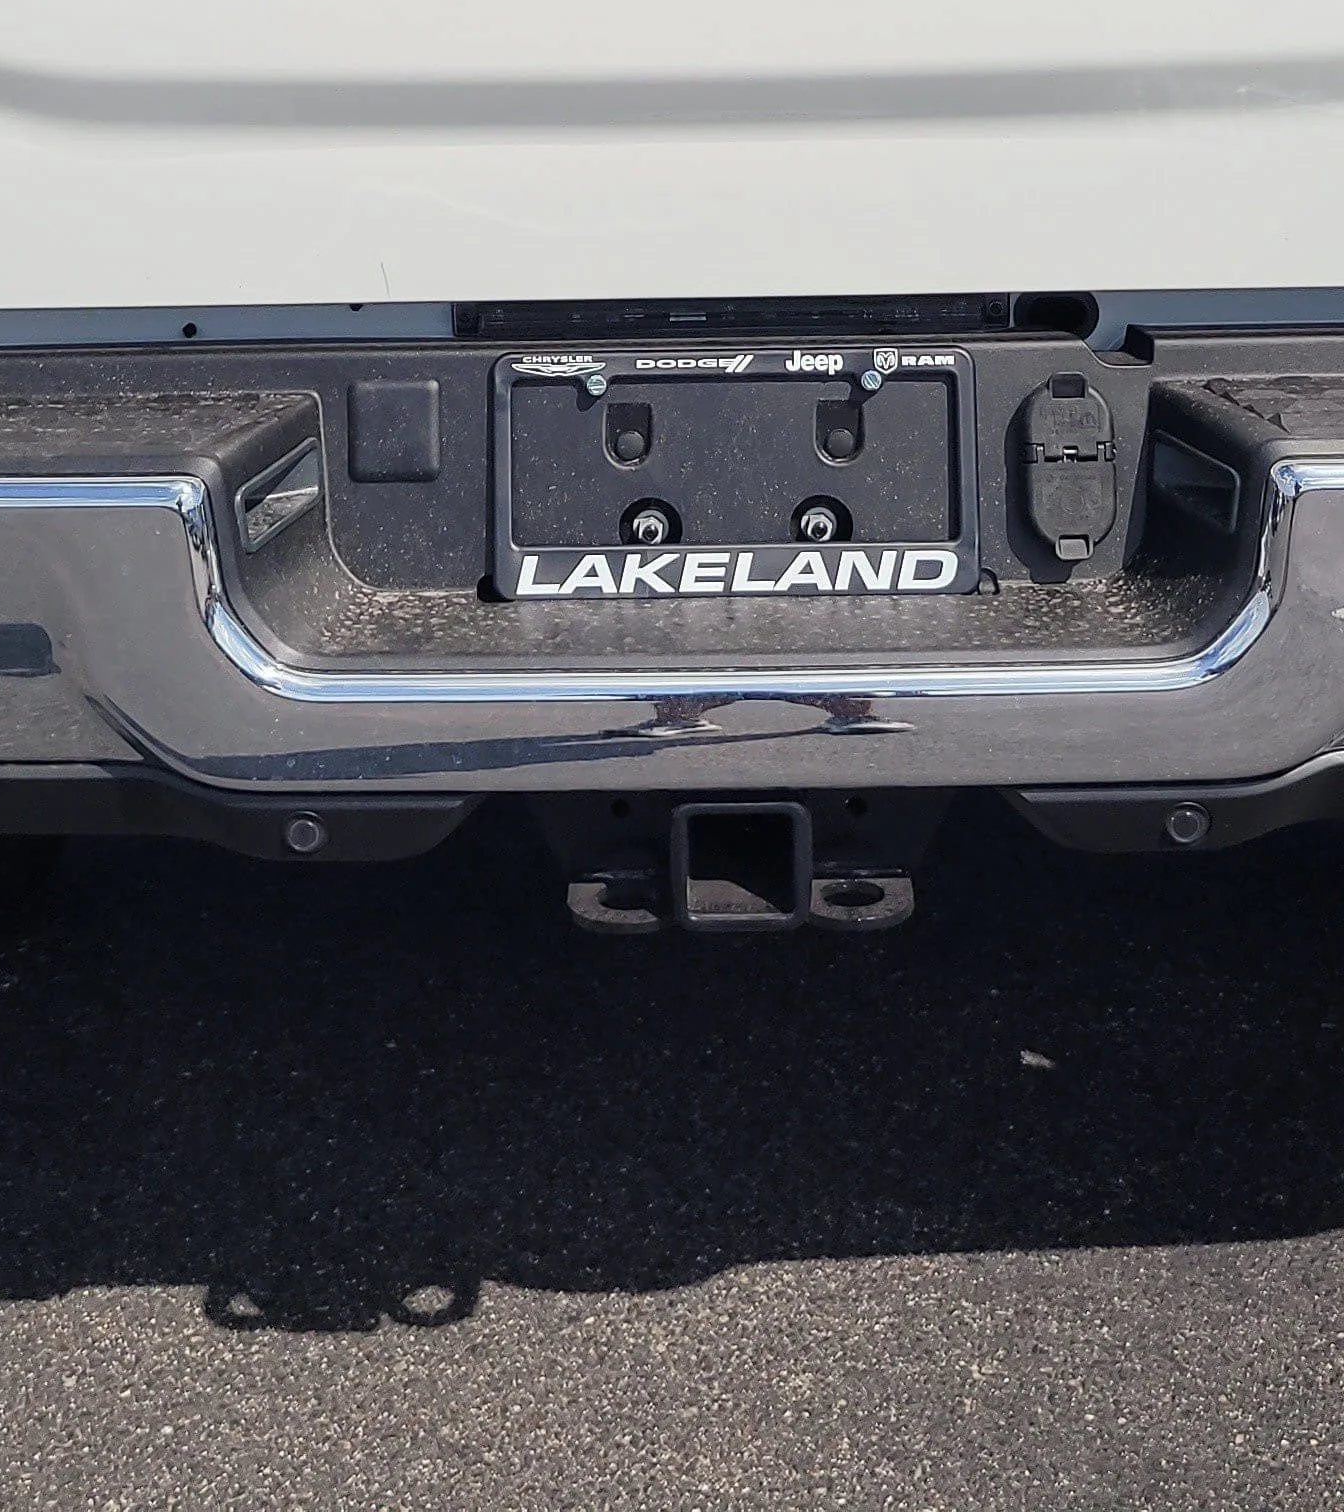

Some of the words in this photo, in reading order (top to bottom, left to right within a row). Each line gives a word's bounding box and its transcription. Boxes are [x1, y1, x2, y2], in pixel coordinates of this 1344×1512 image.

[522, 355, 593, 364] CHRYSLER
[636, 358, 737, 370] DODGE
[785, 350, 844, 375] Jeep
[901, 355, 955, 366] RAM
[515, 550, 958, 595] LAKELAND
